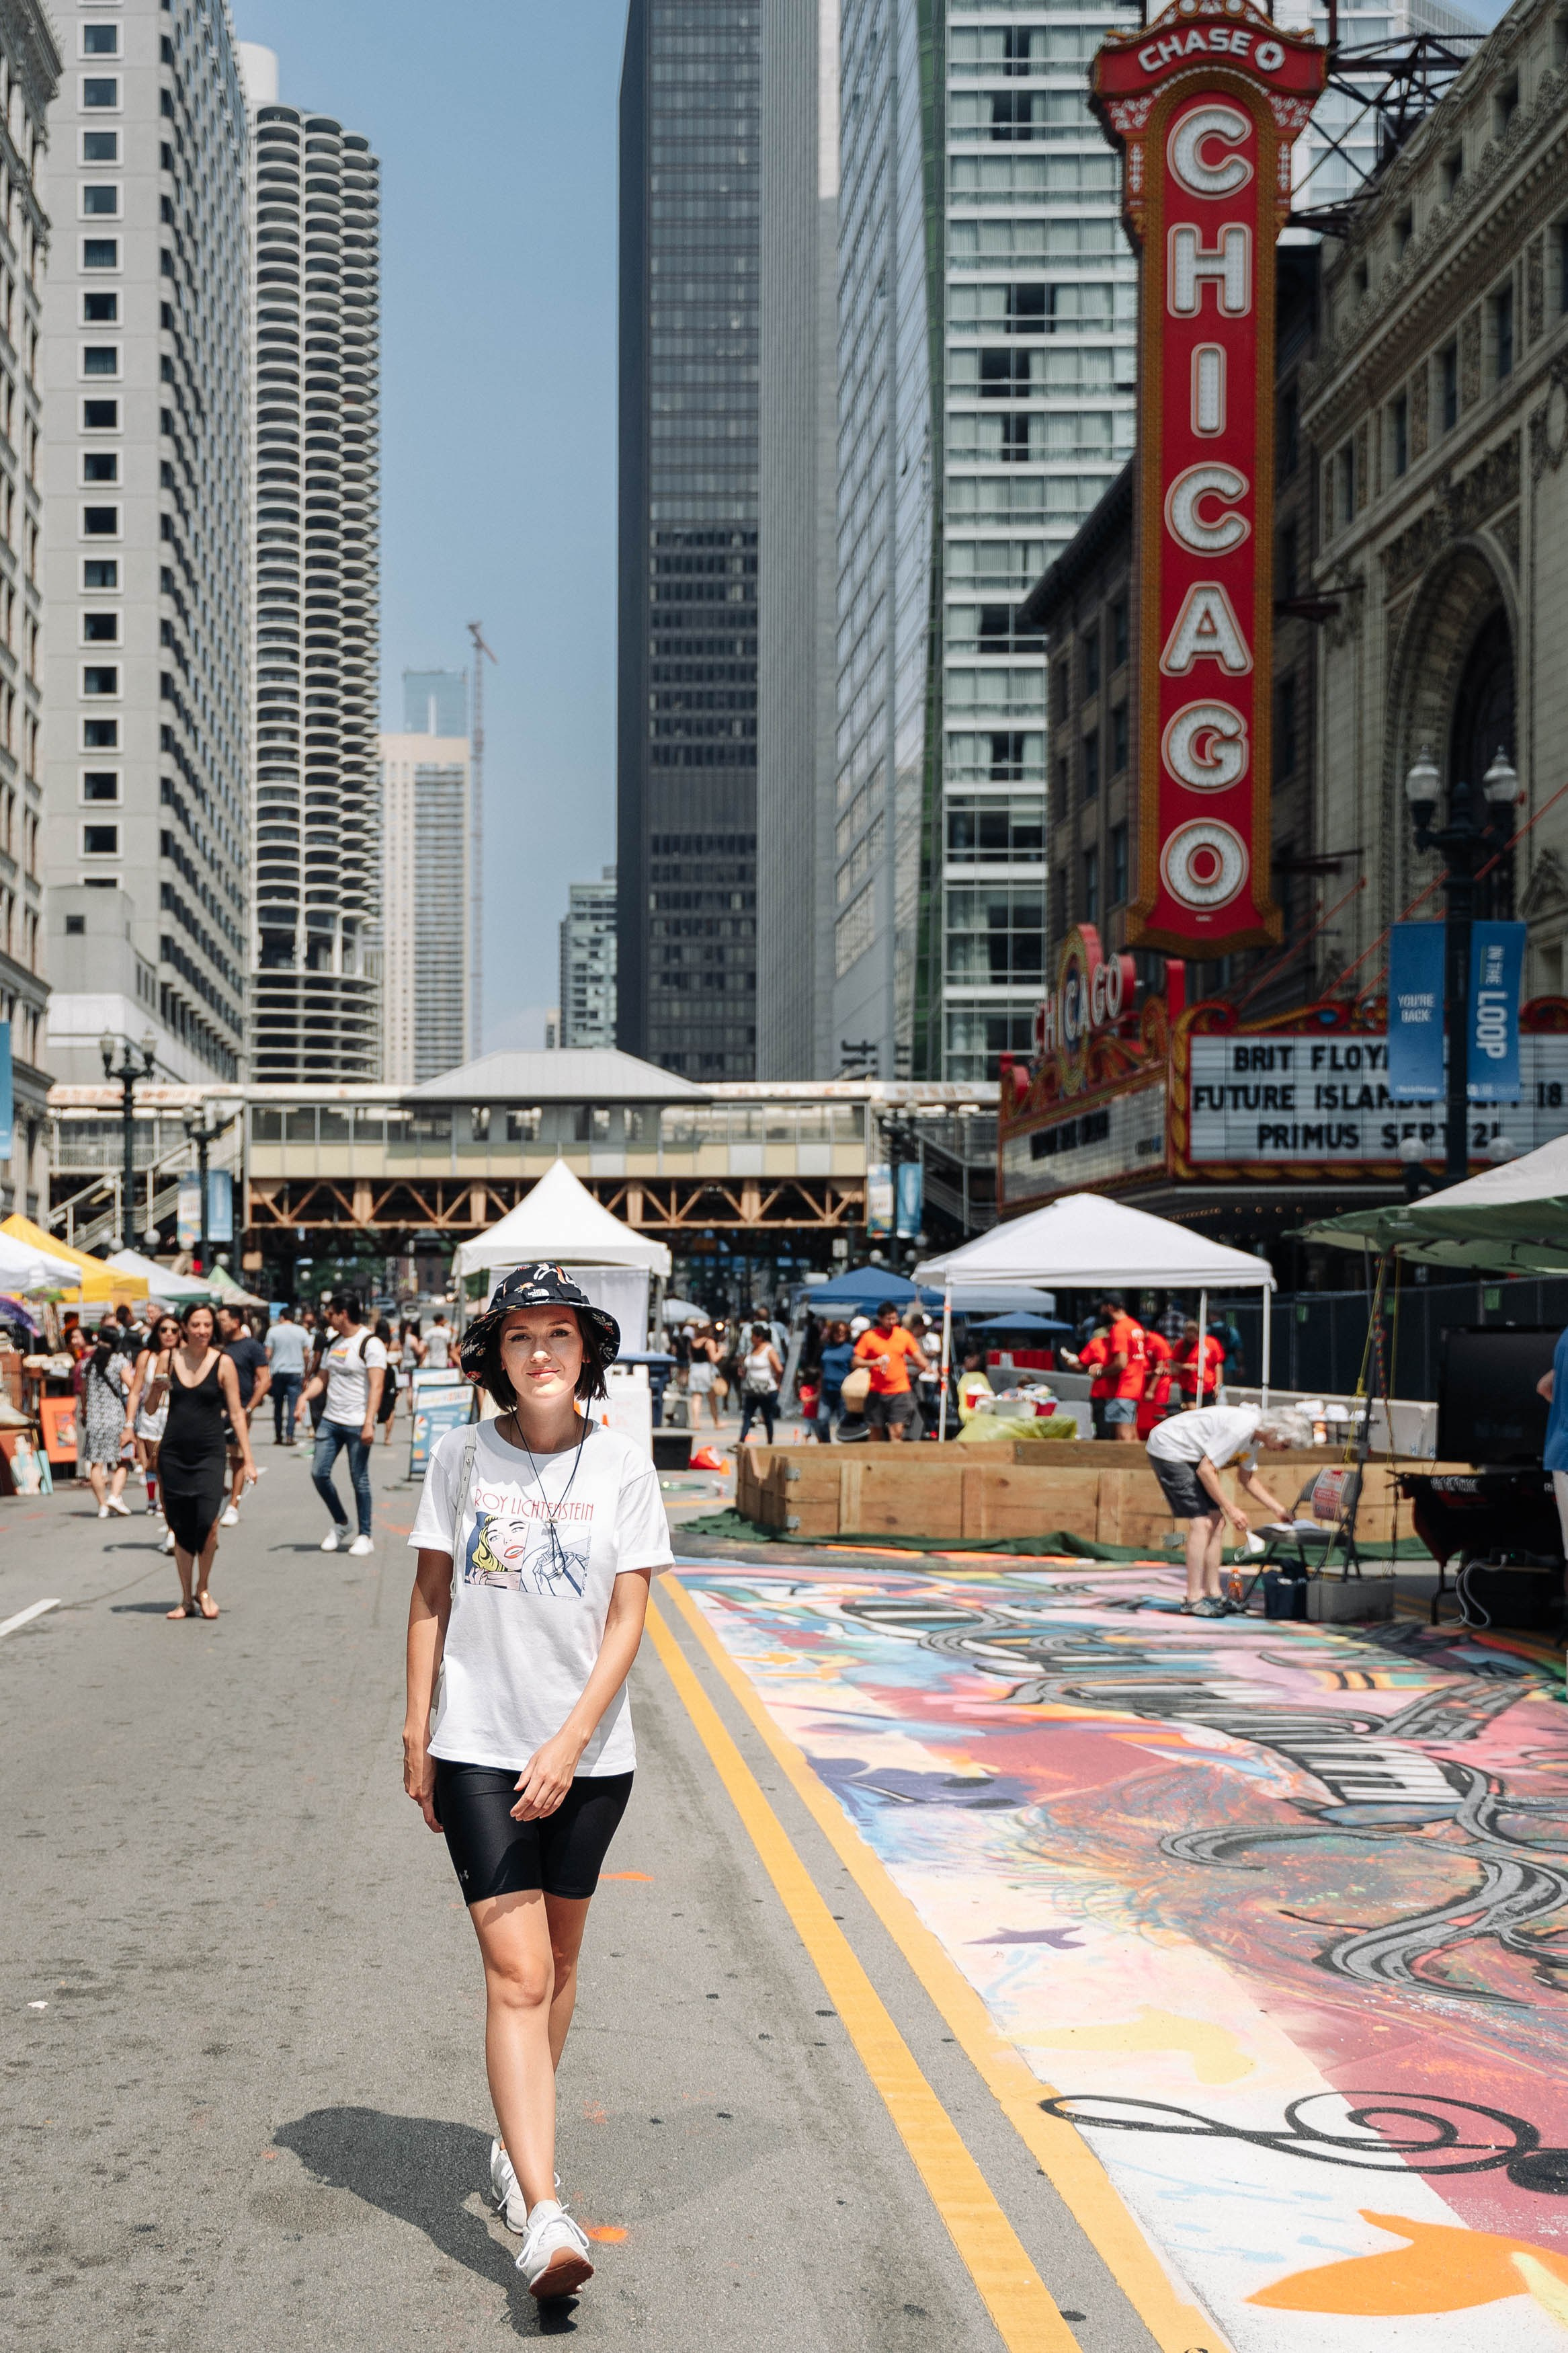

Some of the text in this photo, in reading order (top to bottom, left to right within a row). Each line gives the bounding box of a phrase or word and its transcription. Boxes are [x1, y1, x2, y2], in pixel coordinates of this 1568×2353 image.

[1138, 28, 1253, 72] CHASE
[1159, 104, 1253, 911] CHICAGO
[1031, 952, 1123, 1057] CHICAGO
[1401, 1009, 1432, 1023] BACK
[1476, 945, 1508, 1059] IN THE LOOP
[1233, 1045, 1389, 1072] BRIT FLOY
[1192, 1084, 1296, 1111] FUTURE
[1315, 1084, 1433, 1111] ISLAN
[1537, 1082, 1563, 1108] 18
[1257, 1123, 1359, 1150] PRIMUS
[474, 1488, 594, 1521] ROY LICHTENSTEIN
